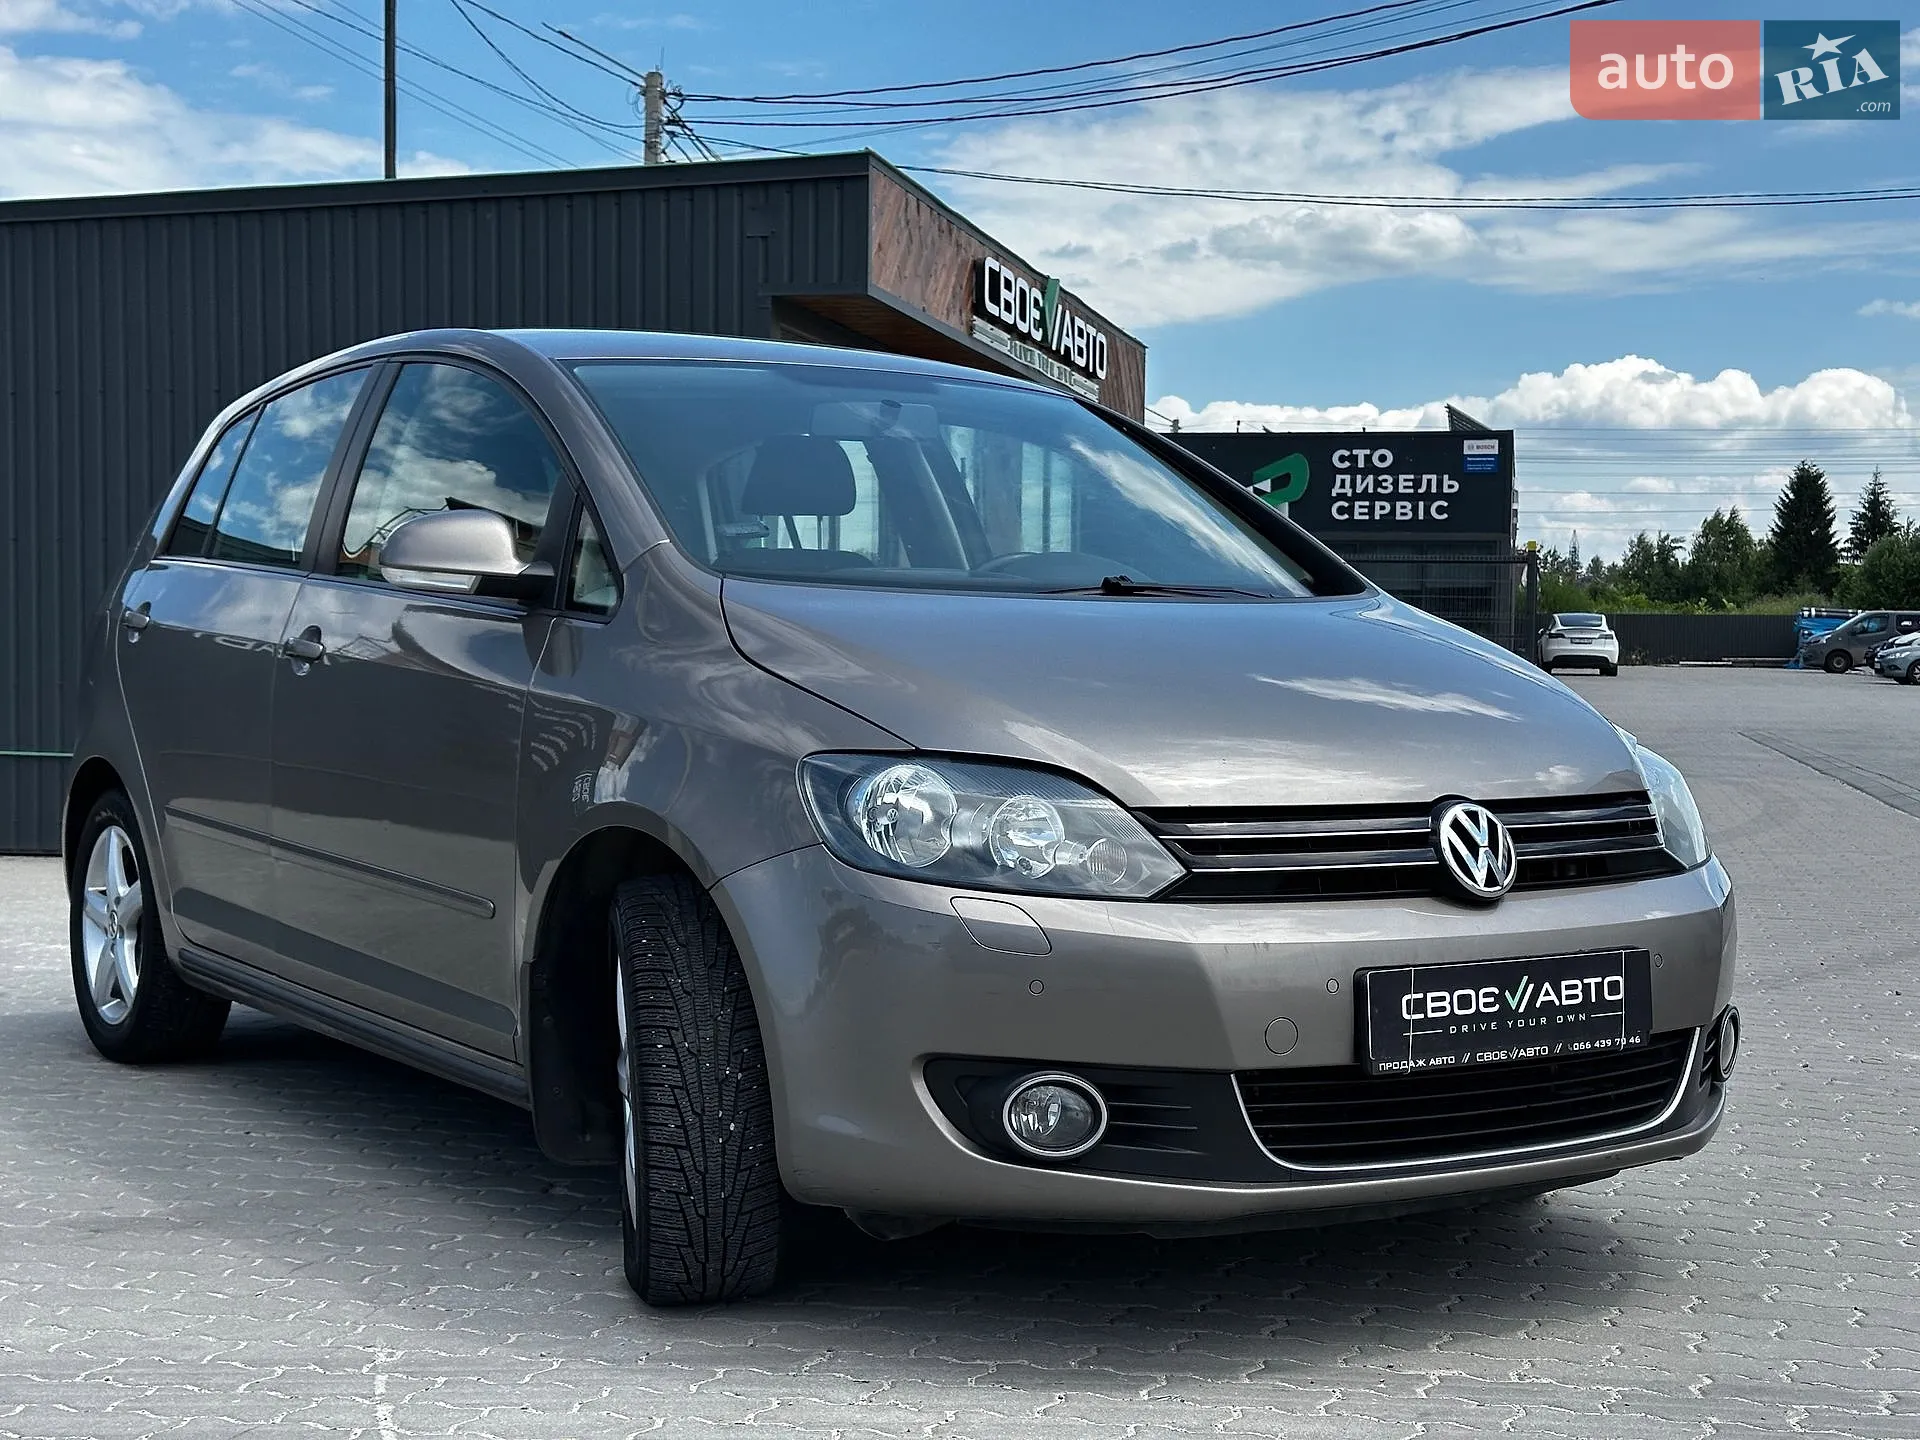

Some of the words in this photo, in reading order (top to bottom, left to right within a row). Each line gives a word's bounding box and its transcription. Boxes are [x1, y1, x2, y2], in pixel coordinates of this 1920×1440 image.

[1331, 448, 1394, 469] СТО
[1331, 474, 1460, 497] ДИЗЕЛЬ
[1331, 500, 1449, 520] СЕРВІС
[1449, 1021, 1498, 1035] DRIVE
[1506, 1016, 1548, 1028] YOUR
[1556, 1013, 1587, 1024] OWN
[1379, 1058, 1427, 1071] ПРОДАЖ
[1429, 1055, 1456, 1066] АВТО
[1572, 1041, 1592, 1051] 066
[1594, 1039, 1612, 1048] 439
[1629, 1035, 1641, 1044] 46
